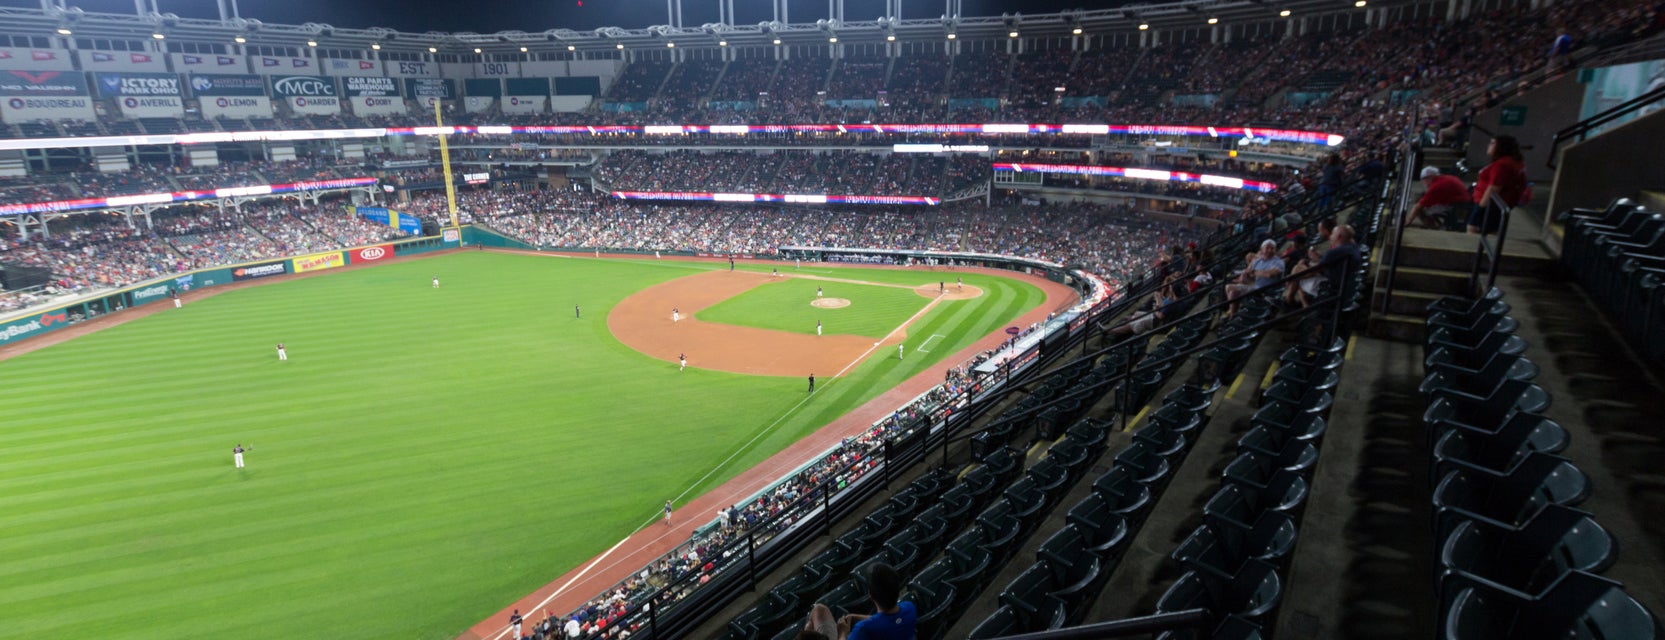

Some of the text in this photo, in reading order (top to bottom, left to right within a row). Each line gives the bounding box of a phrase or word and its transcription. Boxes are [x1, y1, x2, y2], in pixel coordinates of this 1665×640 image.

[399, 63, 430, 75] EST.
[482, 63, 509, 75] 1901
[367, 77, 392, 85] PARTS
[347, 83, 395, 91] WAREHOUSE
[26, 98, 86, 108] BOUDREAU
[139, 98, 179, 107] AVERILL
[228, 98, 258, 106] LEMON
[307, 98, 337, 106] HARDER
[363, 248, 382, 258] KIA
